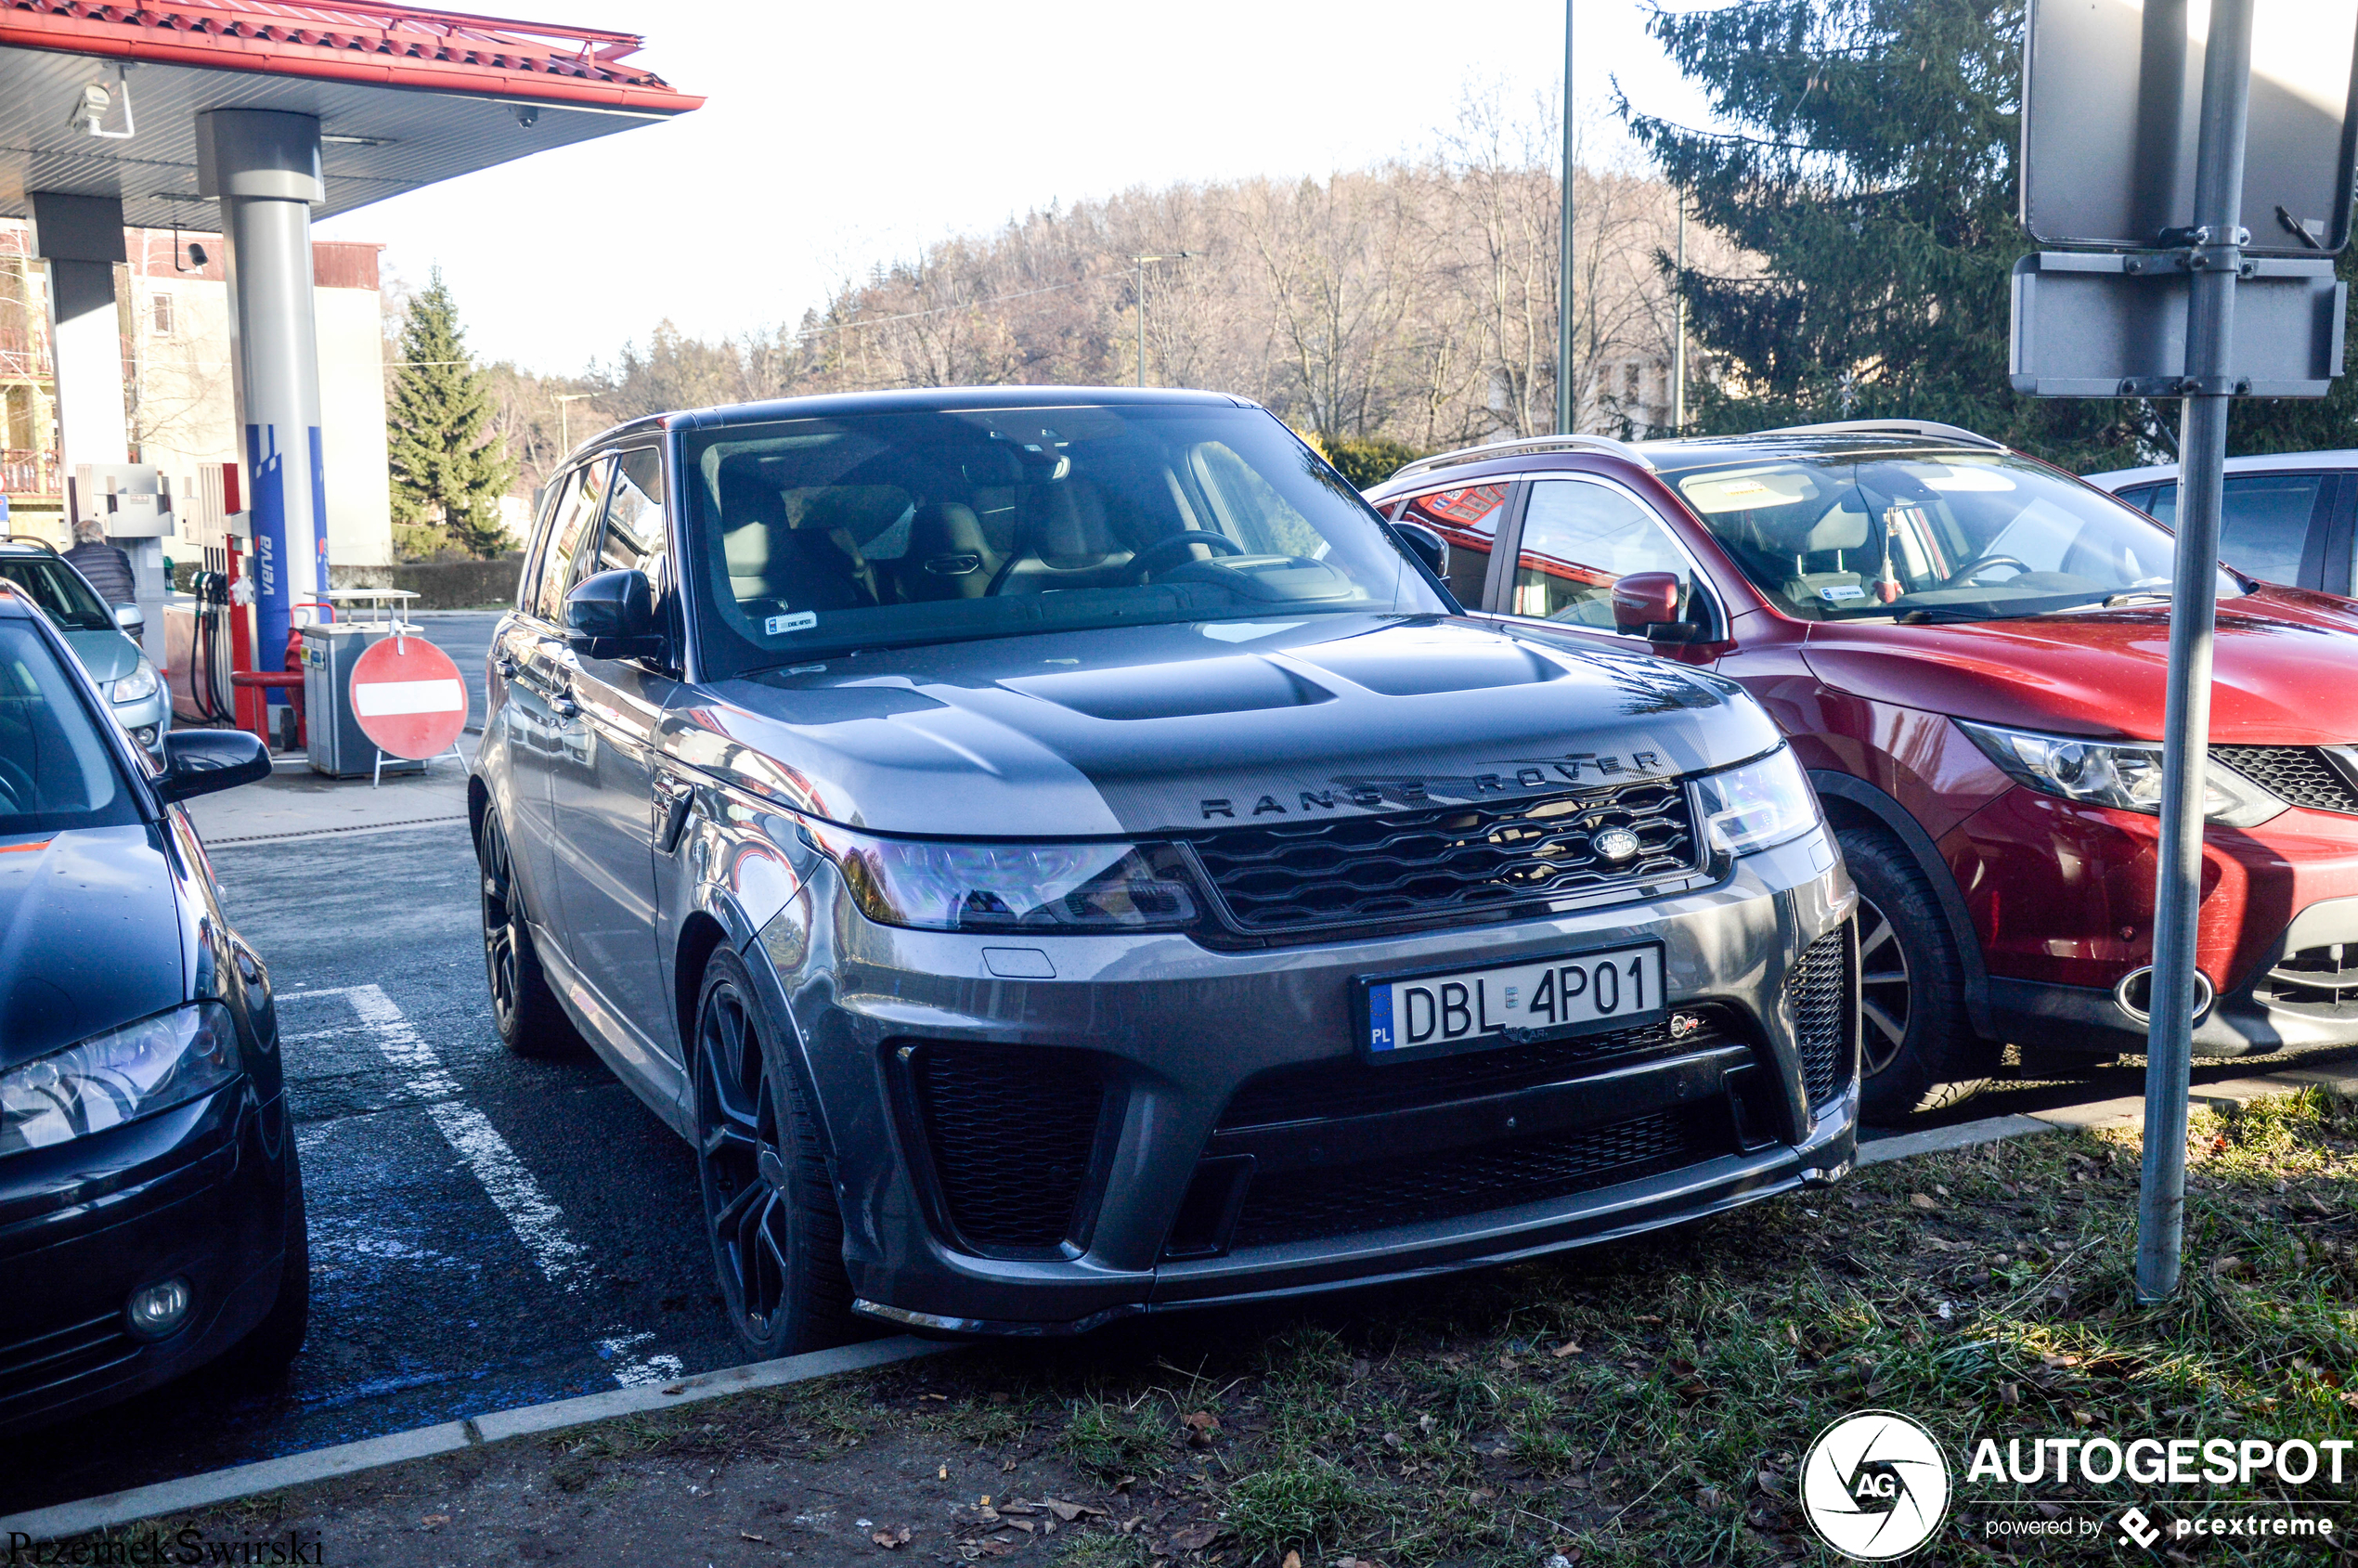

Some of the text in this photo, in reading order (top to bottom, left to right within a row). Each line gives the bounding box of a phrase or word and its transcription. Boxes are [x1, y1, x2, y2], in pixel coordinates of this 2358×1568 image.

[260, 535, 275, 595] verva
[1199, 751, 1663, 820] RANGE ROVER
[1601, 834, 1624, 845] LAND
[1606, 840, 1633, 852] ROVER
[1372, 954, 1644, 1044] PL DBL 4P01
